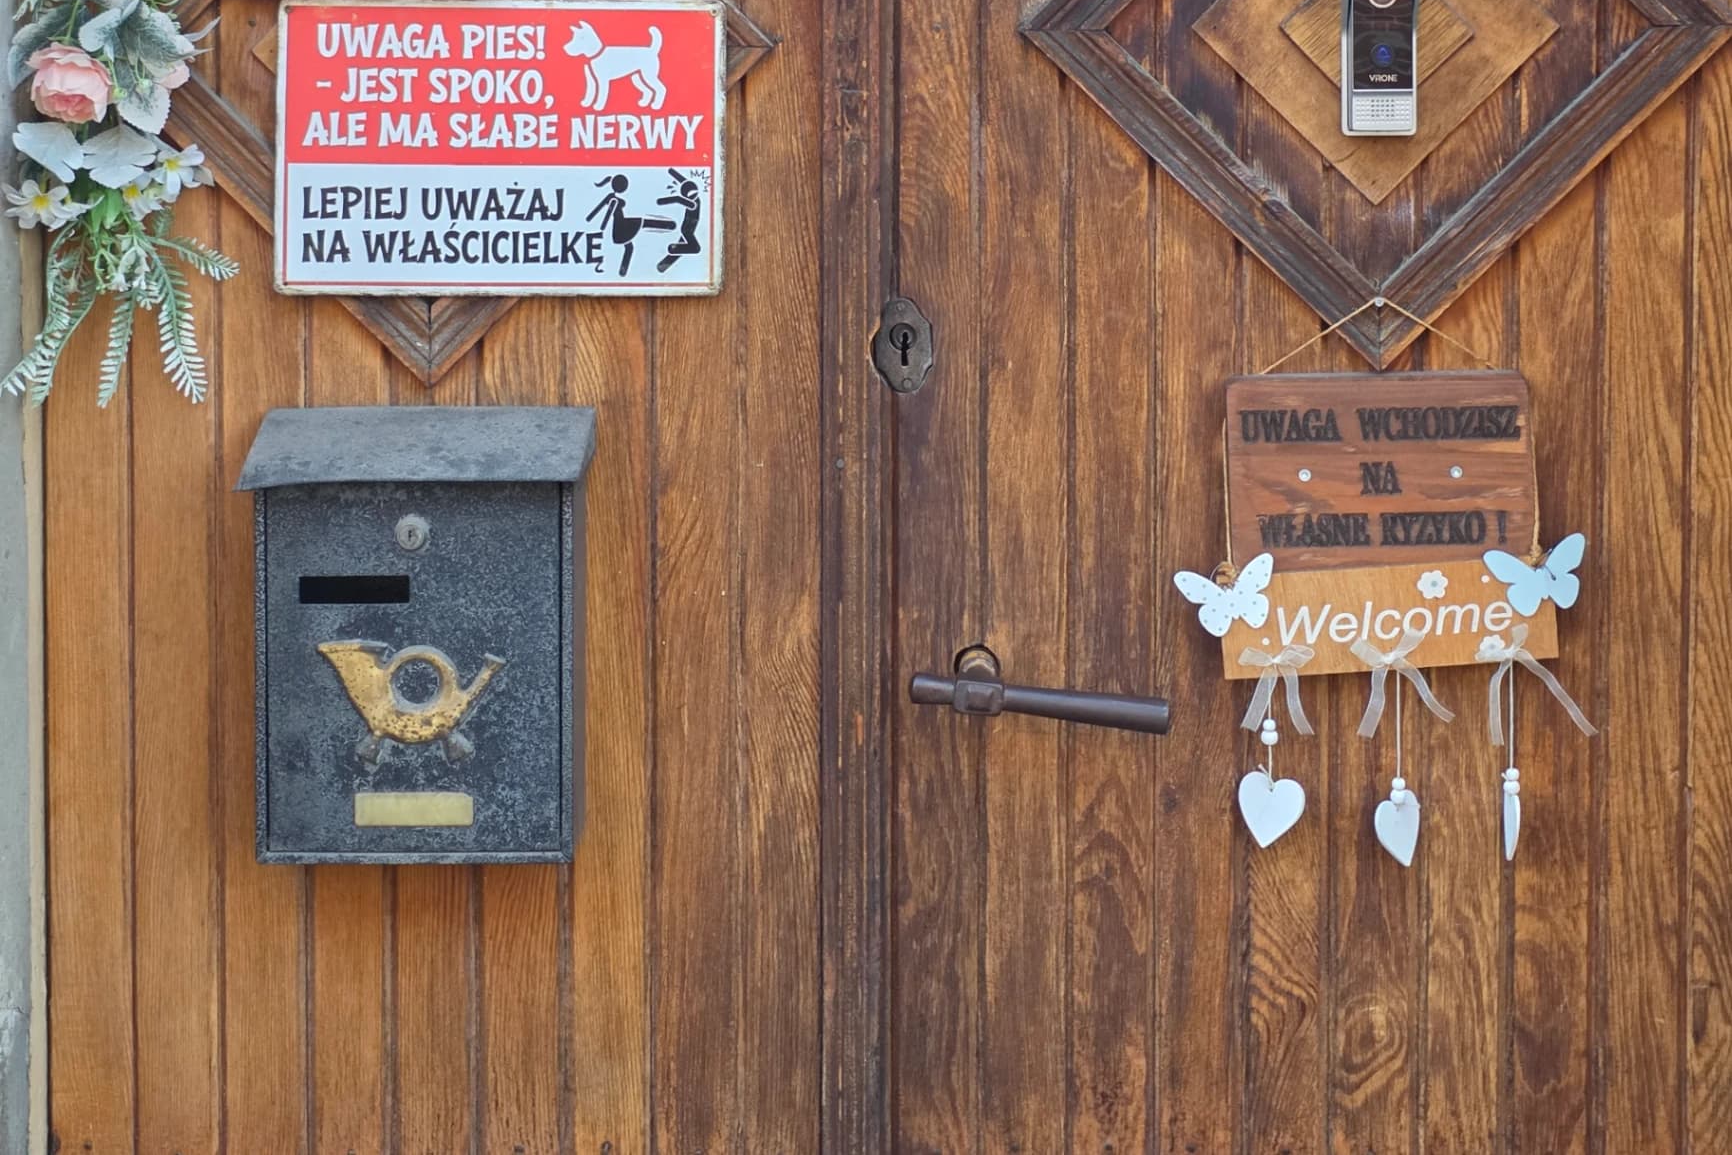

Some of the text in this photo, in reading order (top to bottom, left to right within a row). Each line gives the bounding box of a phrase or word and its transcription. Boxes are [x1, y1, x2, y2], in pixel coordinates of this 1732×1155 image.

[316, 22, 546, 59] UWAGA PIES!
[340, 67, 418, 103] JEST
[428, 69, 555, 110] SPOKO,
[302, 111, 704, 150] ALE MA SŁABE NERWY
[302, 181, 565, 221] LEPIEJ UWAŻAJ
[302, 222, 604, 273] NA WŁAŚCICIELKĘ
[1237, 405, 1521, 443] UWAGA WCHODZISZ
[1359, 461, 1402, 496] NA
[1379, 510, 1487, 546] RYZYKO
[1277, 600, 1513, 646] Welcome
